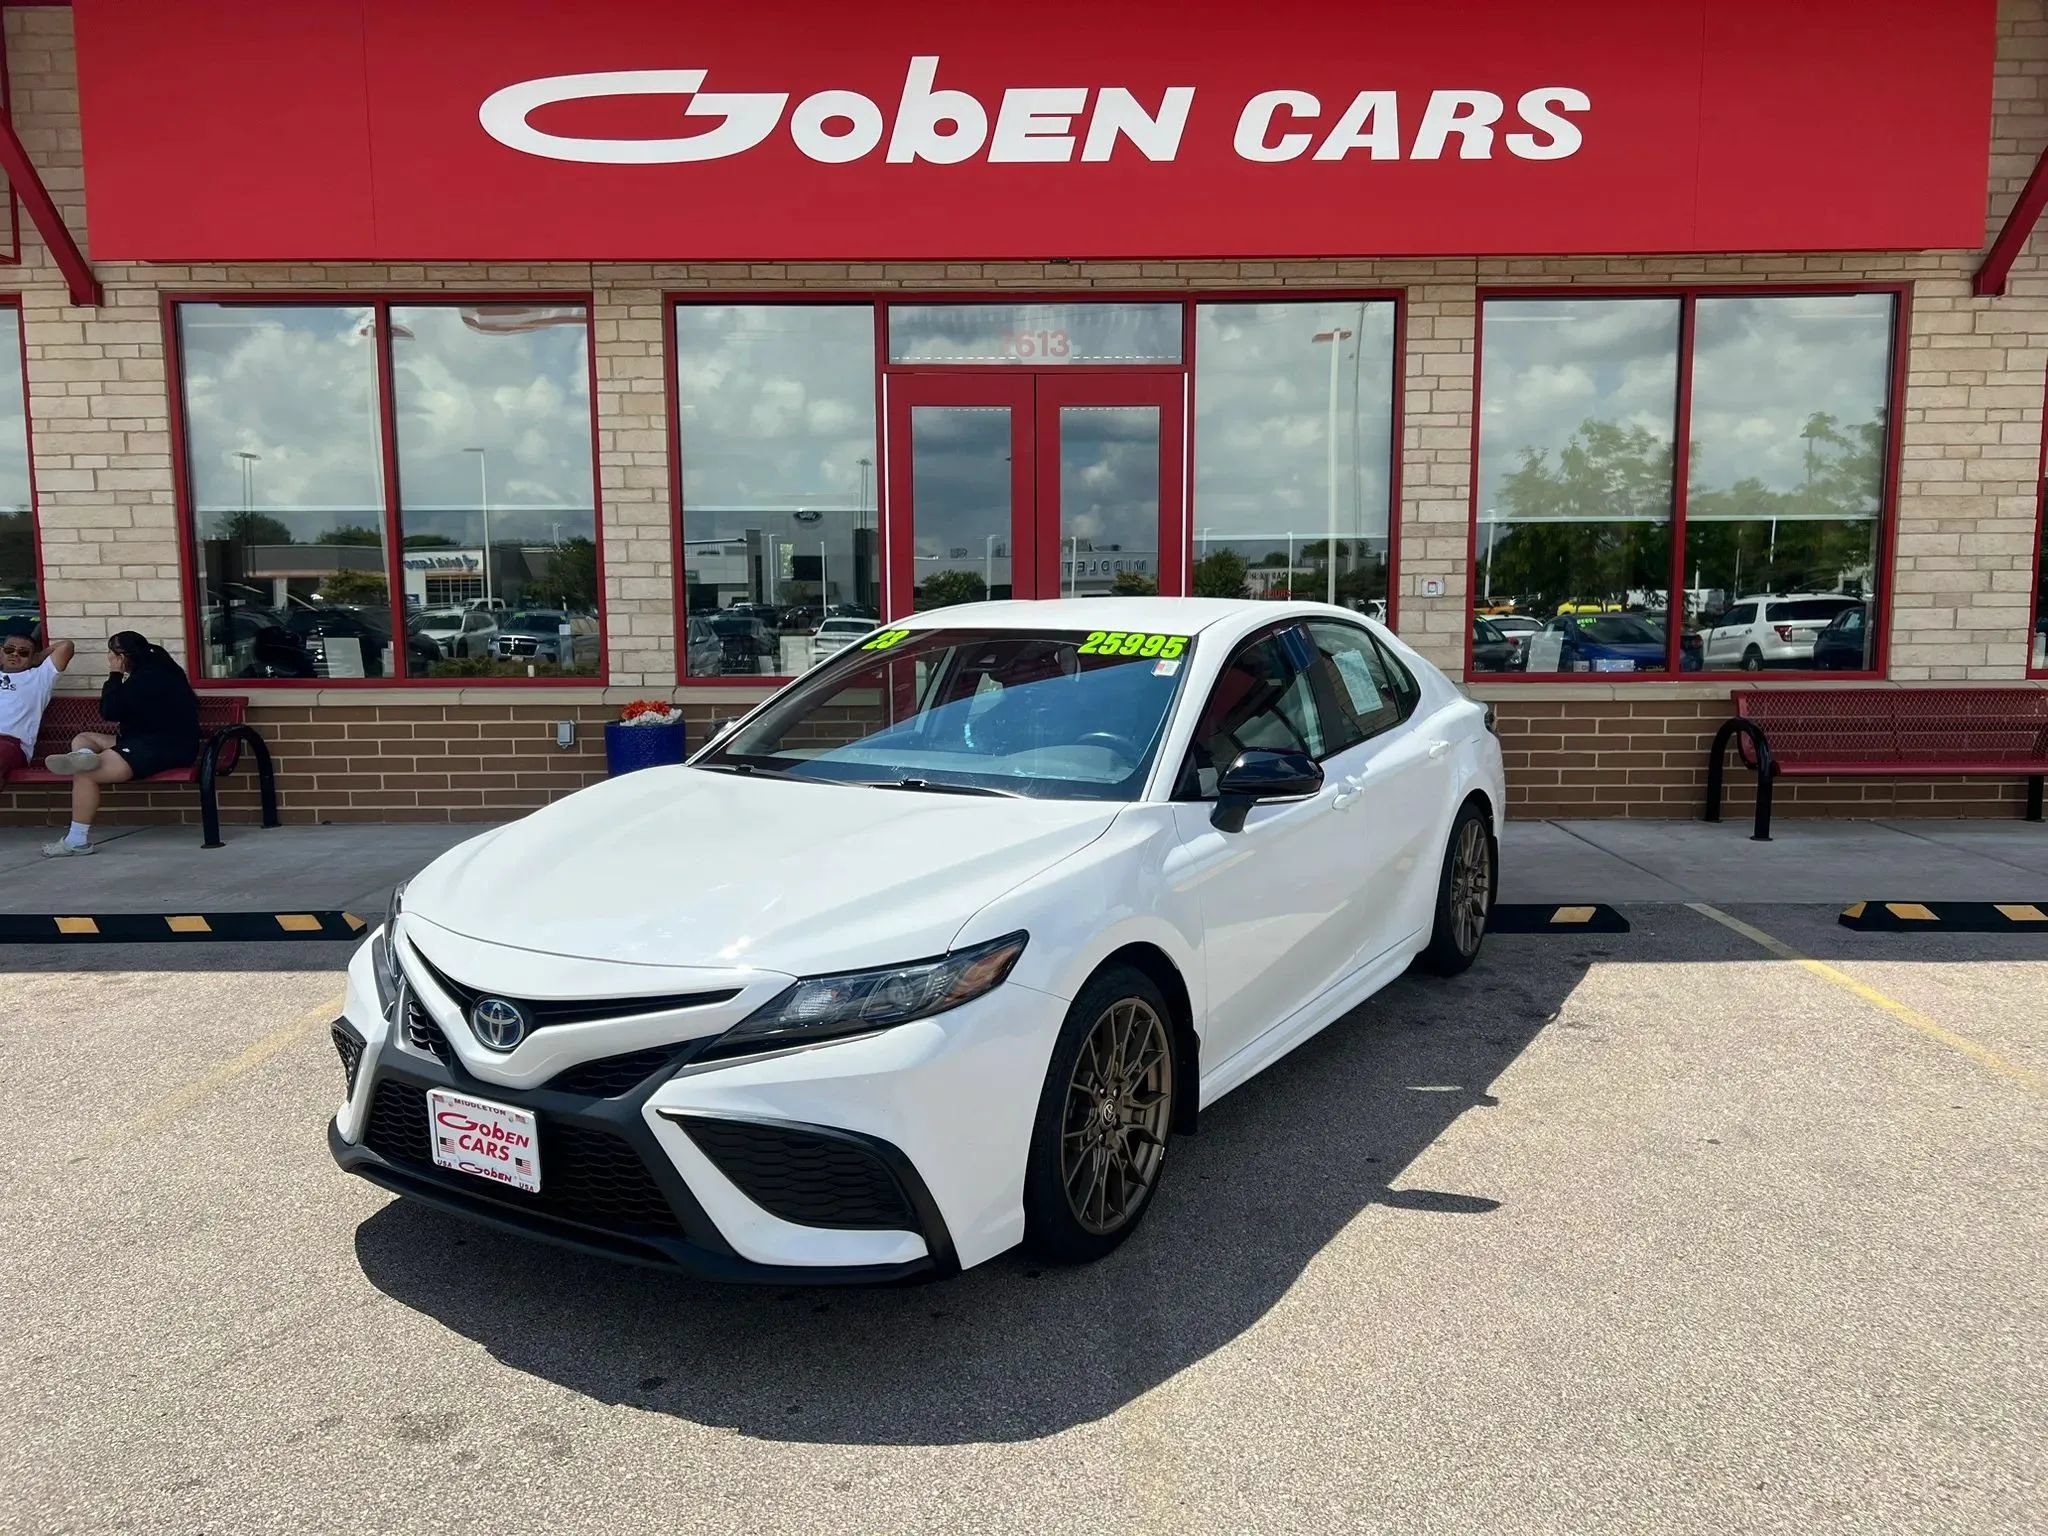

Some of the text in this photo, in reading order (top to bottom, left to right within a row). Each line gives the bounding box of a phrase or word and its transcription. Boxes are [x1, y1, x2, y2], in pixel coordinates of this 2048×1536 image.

[1231, 86, 1591, 163] CARS
[1077, 631, 1188, 659] 25995
[454, 1097, 507, 1116] MIDDLETON
[458, 1134, 510, 1161] CARS
[437, 1159, 453, 1169] USA
[518, 1182, 534, 1192] USA
